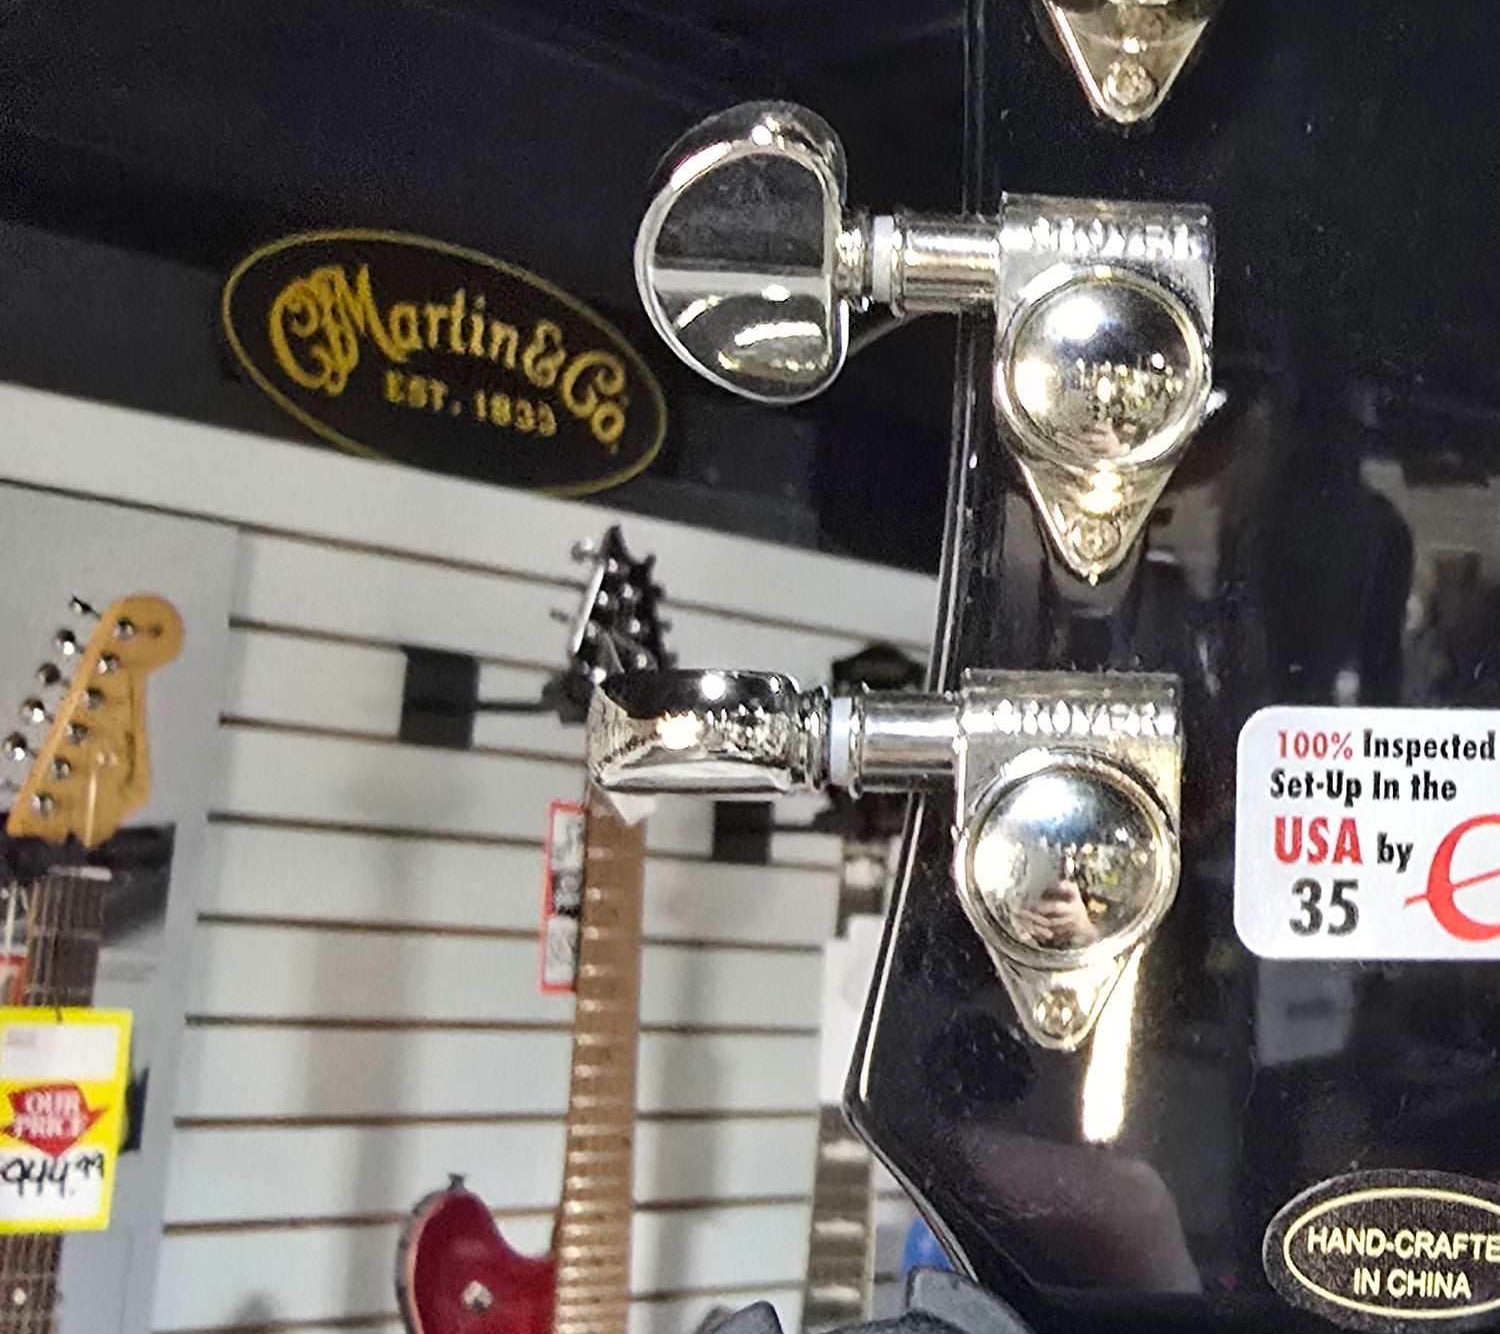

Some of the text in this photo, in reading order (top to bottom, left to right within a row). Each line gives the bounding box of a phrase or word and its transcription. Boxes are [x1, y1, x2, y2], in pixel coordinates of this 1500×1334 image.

[1276, 729, 1354, 761] 100%
[1363, 729, 1496, 767] Inspected
[1269, 768, 1458, 808] Set-Up In the
[1273, 815, 1364, 866] USA
[1376, 831, 1414, 873] by
[1288, 877, 1360, 937] 35
[1353, 1267, 1472, 1300] IN CHINA
